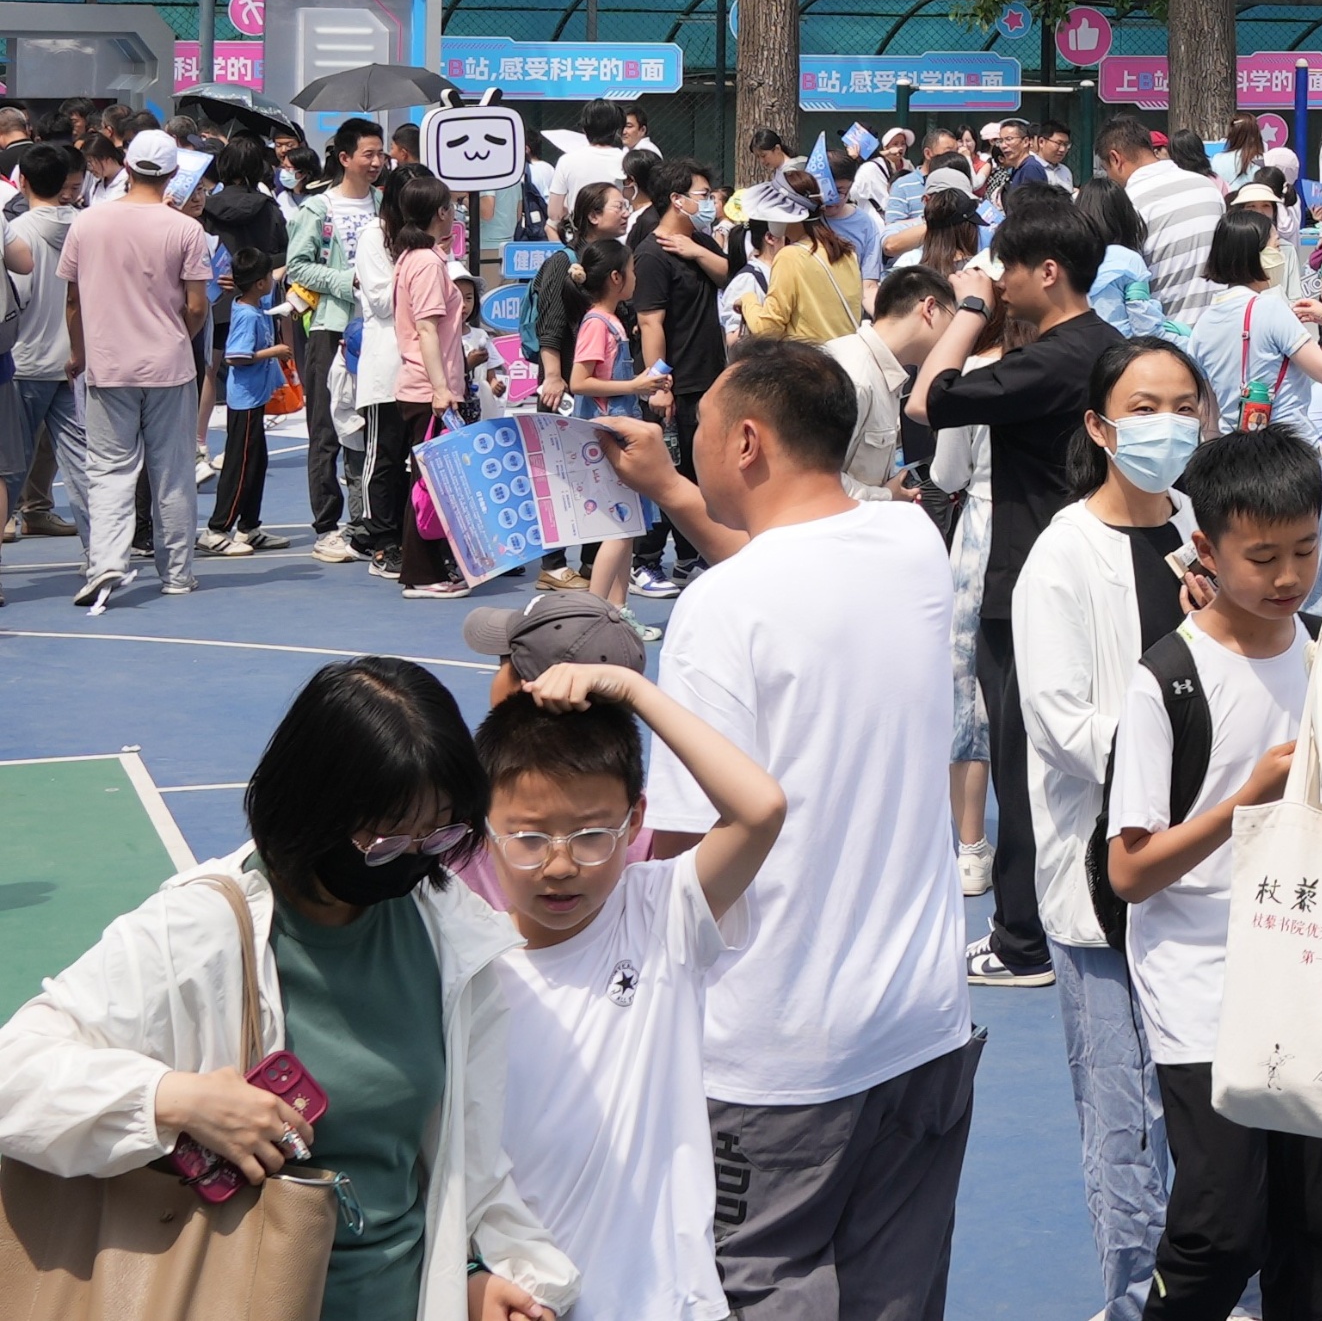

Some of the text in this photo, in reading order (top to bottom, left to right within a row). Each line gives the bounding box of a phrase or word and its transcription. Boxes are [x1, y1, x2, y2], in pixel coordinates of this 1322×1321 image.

[440, 57, 665, 81] B站,感受科学的B面
